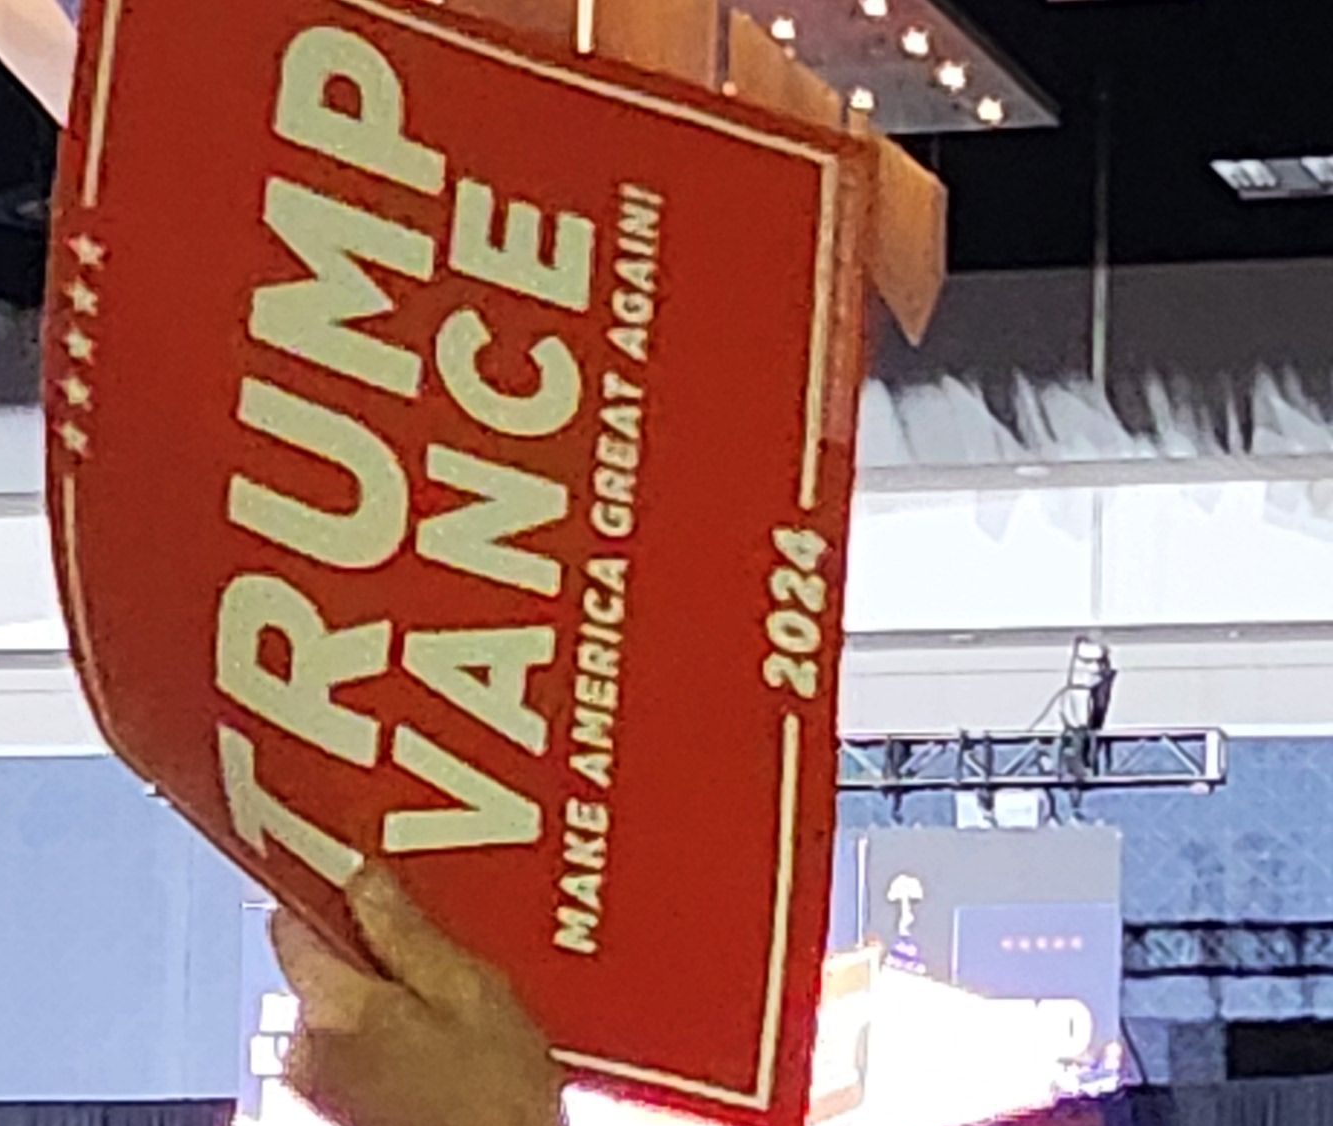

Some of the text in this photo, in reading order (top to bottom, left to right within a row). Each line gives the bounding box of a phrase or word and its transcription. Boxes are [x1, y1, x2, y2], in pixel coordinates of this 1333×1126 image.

[215, 25, 446, 889] TRUMP
[383, 178, 596, 854] VANCE
[553, 182, 664, 954] MAKE AMERICA GREAT AGAIN!
[763, 528, 829, 699] 2024
